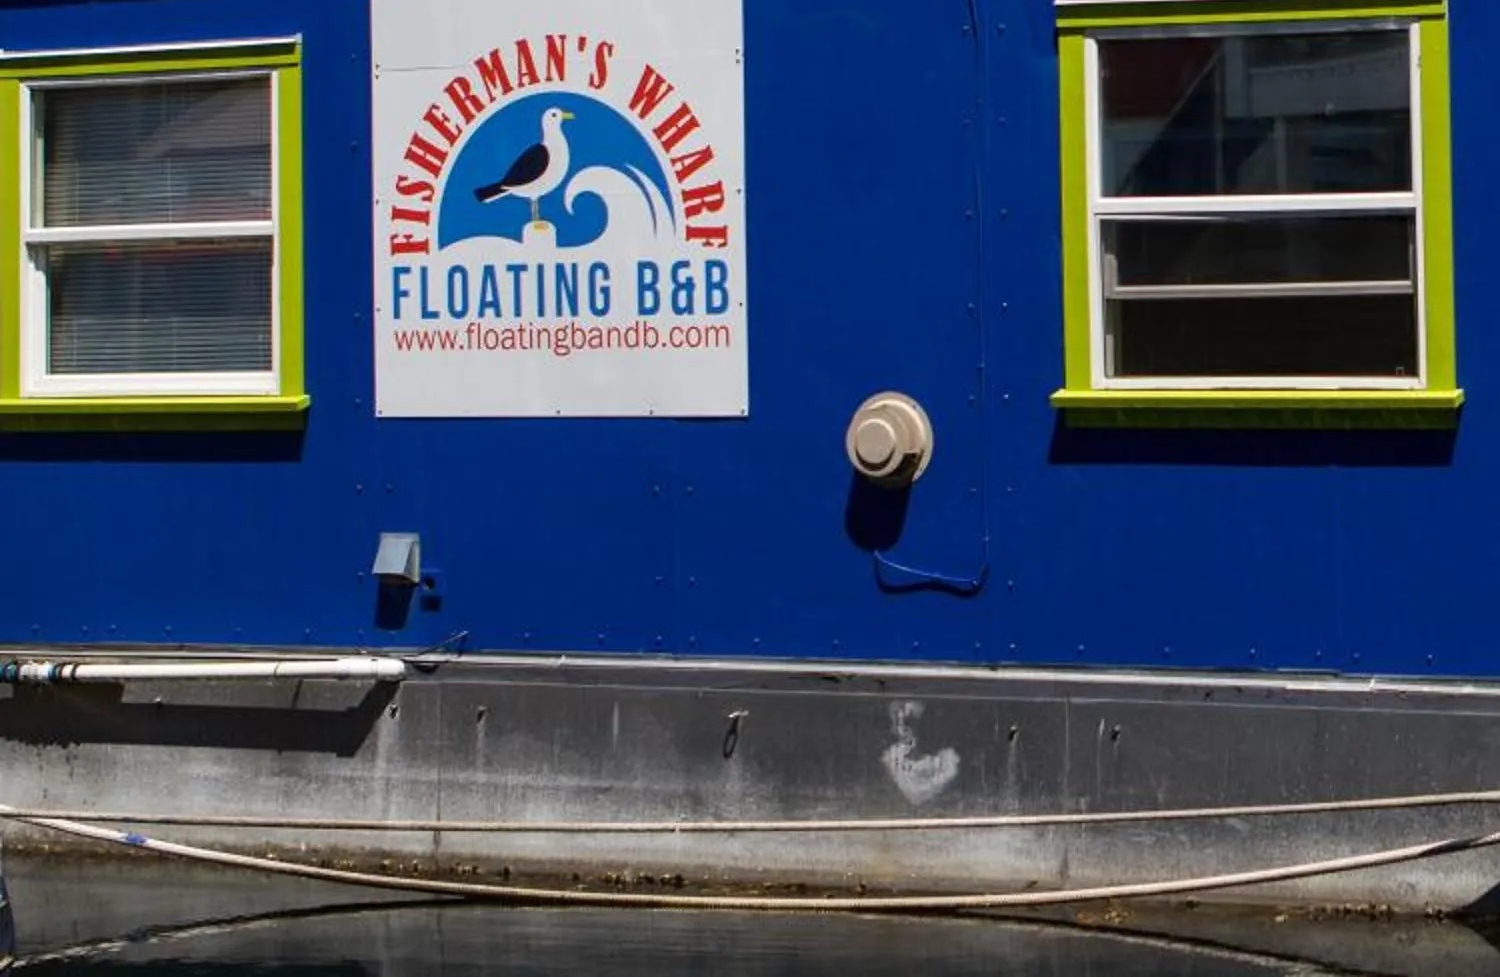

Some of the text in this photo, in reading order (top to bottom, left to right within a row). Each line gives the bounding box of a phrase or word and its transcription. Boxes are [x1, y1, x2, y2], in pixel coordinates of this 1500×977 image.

[390, 34, 729, 256] FISHERMAN'S WHARF
[392, 259, 730, 320] FLOATING B&B
[393, 321, 731, 356] www.floatingbandb.com
